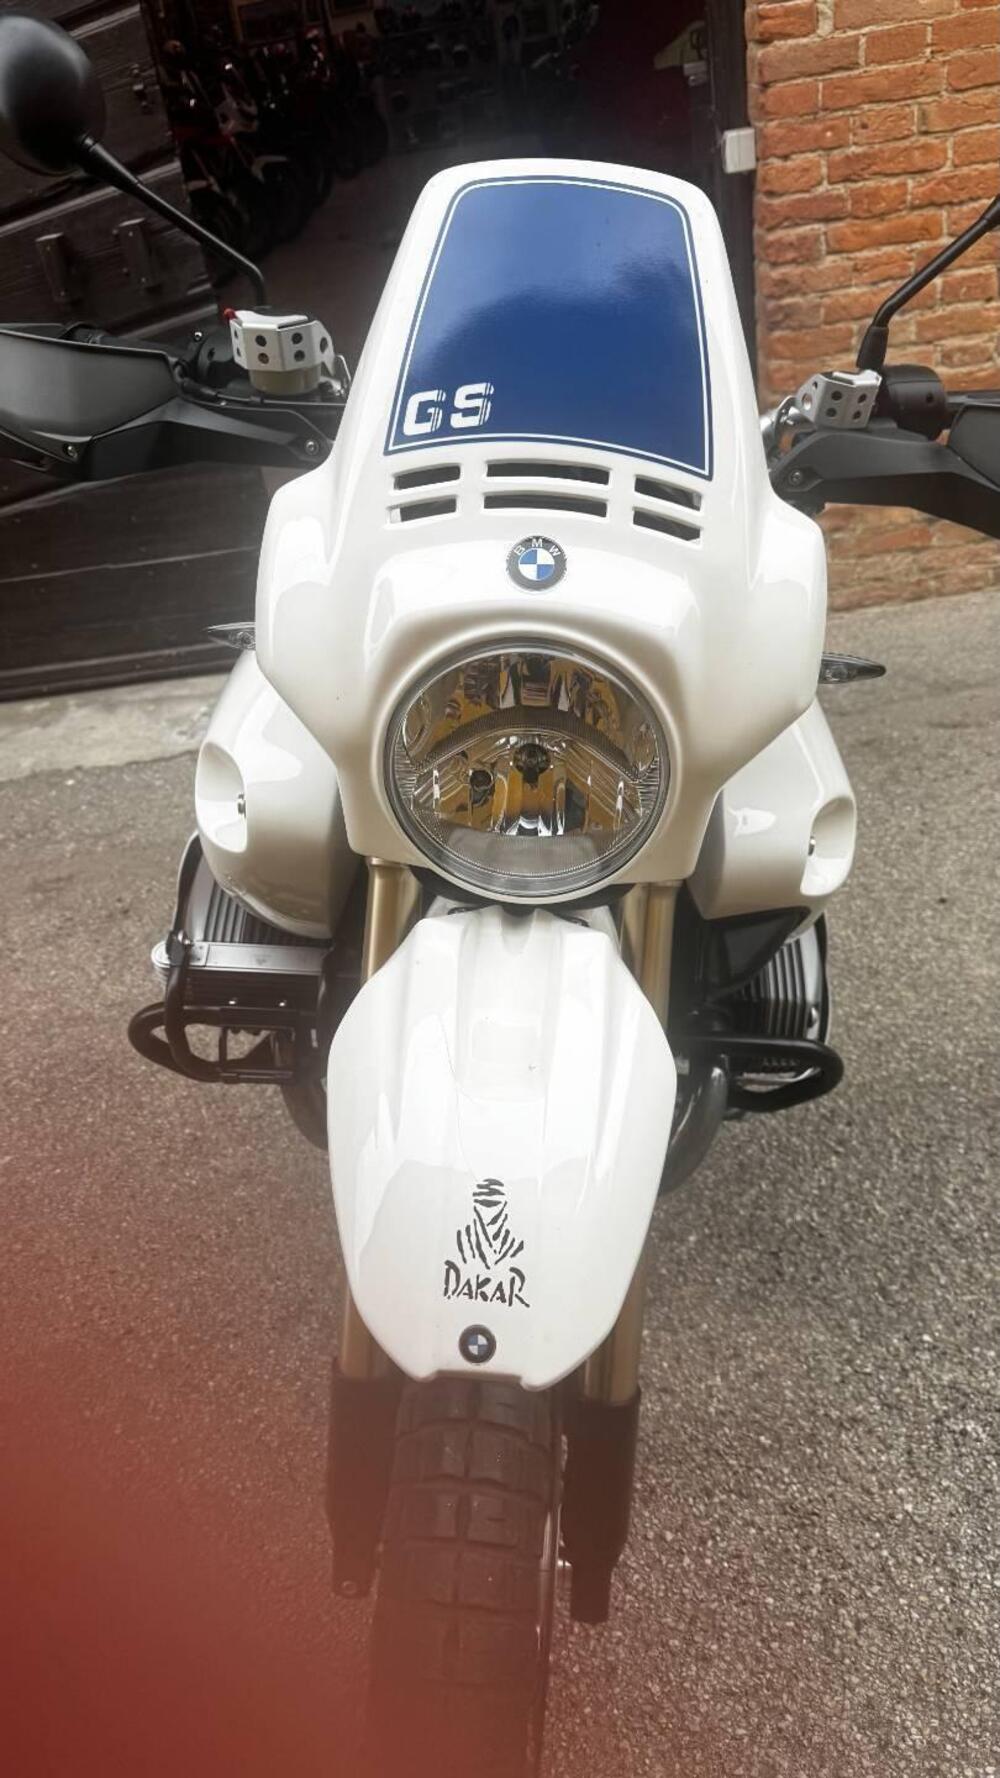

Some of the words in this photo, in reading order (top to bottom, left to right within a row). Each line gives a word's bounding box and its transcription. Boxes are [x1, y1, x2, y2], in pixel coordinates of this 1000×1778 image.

[403, 382, 495, 436] GS
[513, 538, 562, 557] BMW
[443, 1260, 530, 1308] DAKAR
